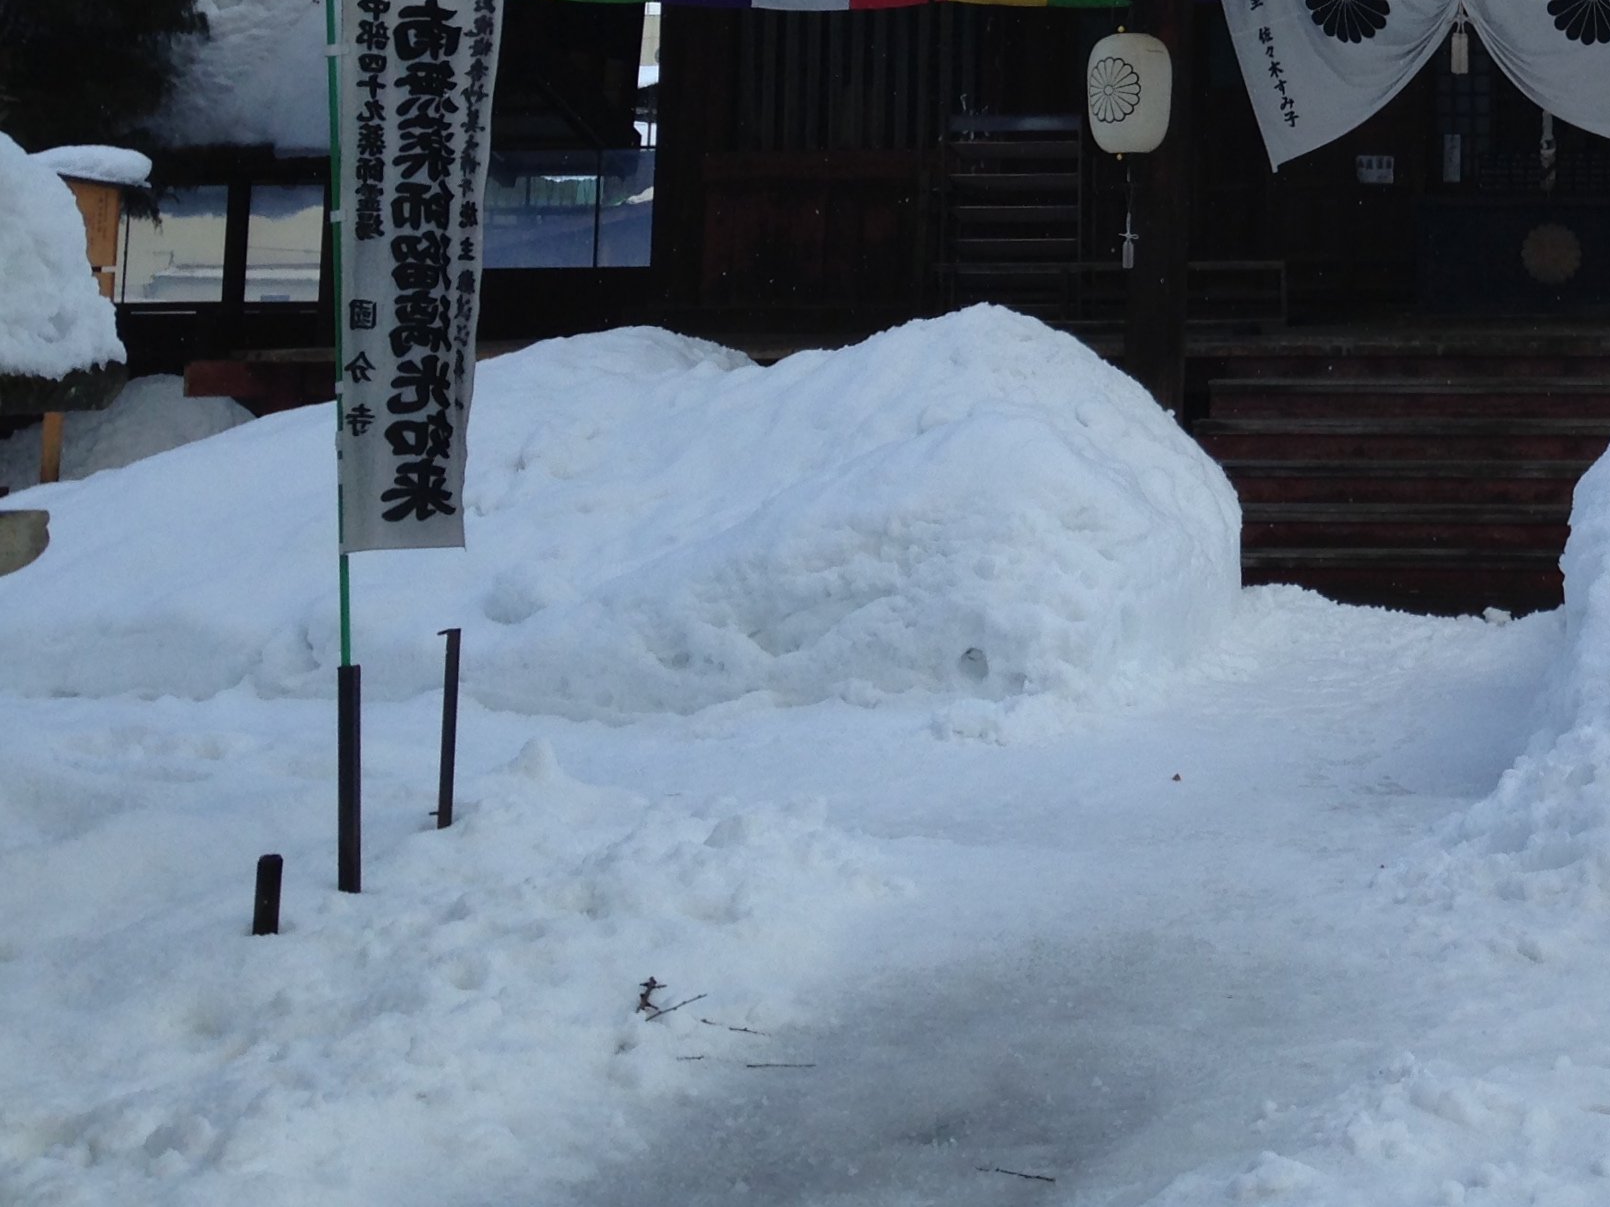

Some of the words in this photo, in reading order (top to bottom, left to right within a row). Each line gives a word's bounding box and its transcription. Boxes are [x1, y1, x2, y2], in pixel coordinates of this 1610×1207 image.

[1258, 26, 1299, 128] 佐々木すみ子
